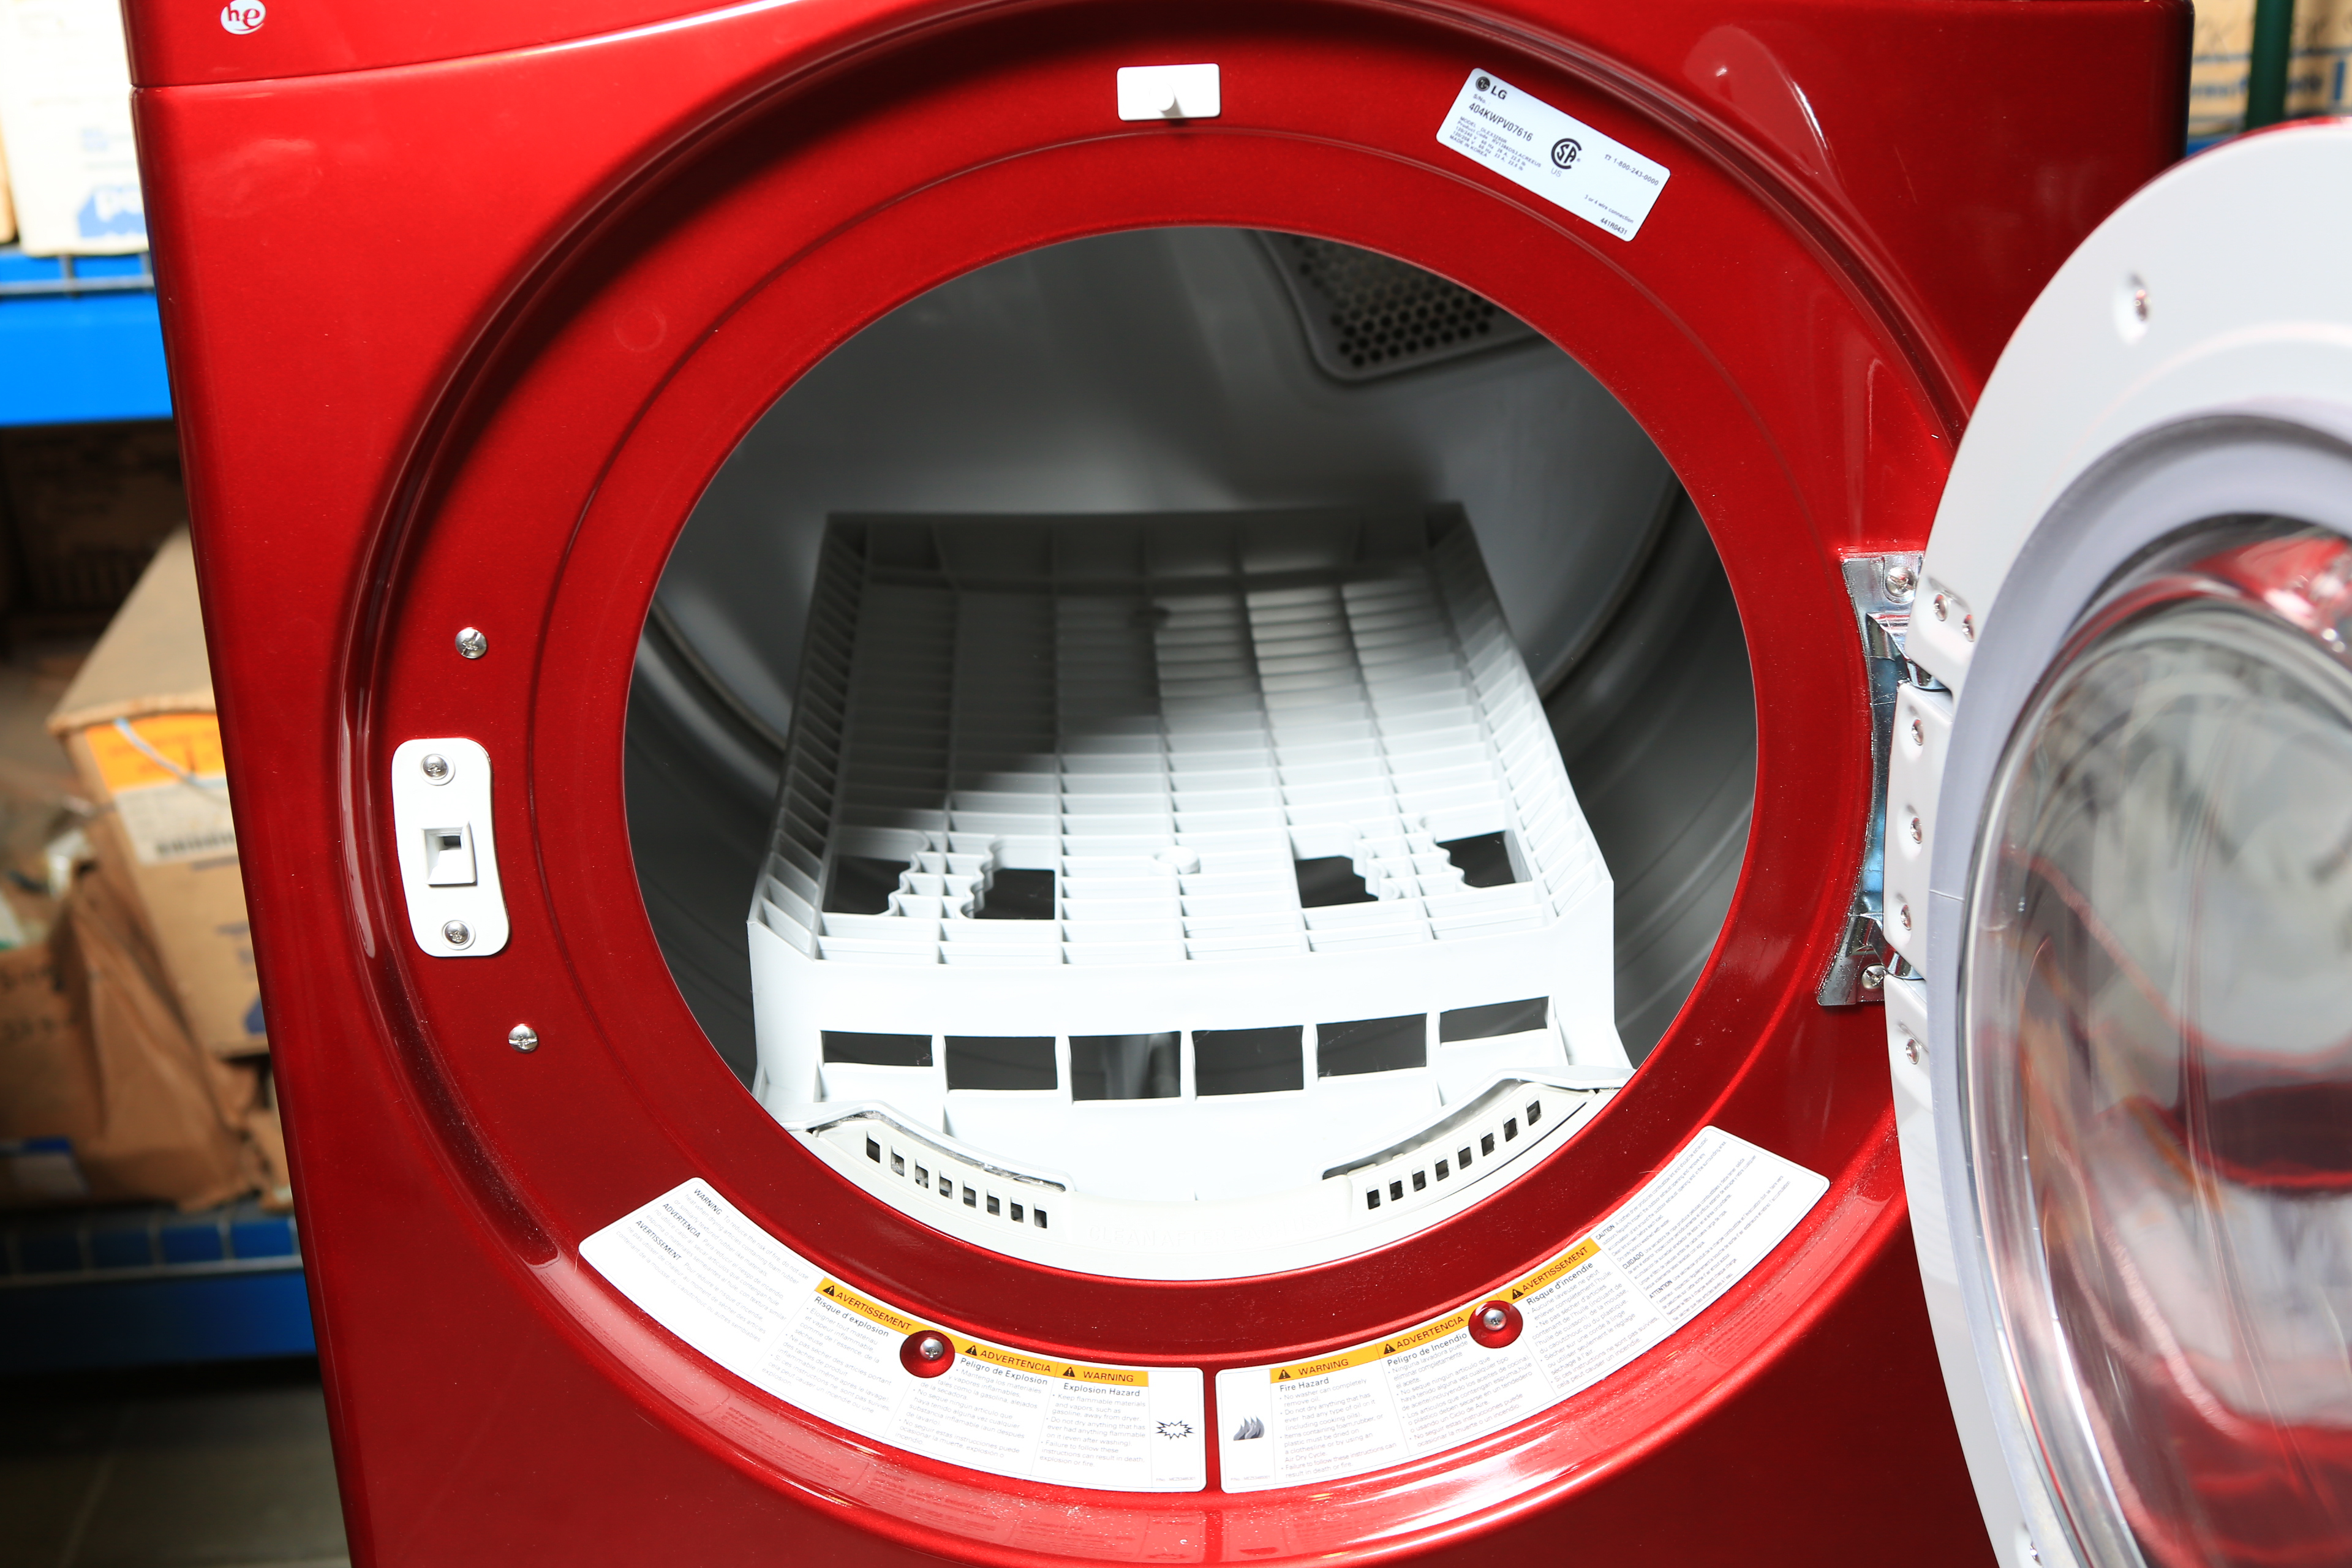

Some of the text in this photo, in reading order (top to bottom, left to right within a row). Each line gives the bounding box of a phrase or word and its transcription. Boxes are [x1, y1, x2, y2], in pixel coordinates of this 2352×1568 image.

[1490, 85, 1507, 99] LG
[1469, 102, 1532, 141] 404KWPV07616
[1550, 167, 1562, 177] US
[1613, 158, 1659, 186] 1-800-243-0000
[1608, 208, 1634, 224] connection
[1600, 217, 1627, 235] 441R0431
[694, 1188, 722, 1215] WARNING
[662, 1203, 700, 1237] ADVERTENCIA
[635, 1220, 681, 1260] AVERTISSEMENT
[1595, 1224, 1615, 1240] CAUTION
[1523, 1246, 1587, 1291] AVERTISSEMENT
[1622, 1251, 1644, 1269] CUIDADO
[1526, 1263, 1593, 1305] Risque d'incendie
[1649, 1280, 1672, 1298] ATTENTION
[814, 1295, 888, 1336] Risque d'explosion
[836, 1292, 911, 1329] AVERTISSEMENT
[1396, 1316, 1464, 1348] ADVERTENCIA
[1387, 1352, 1417, 1366] Peligro
[1430, 1333, 1467, 1351] Incendio
[960, 1357, 990, 1371] Peligro
[980, 1350, 1050, 1371] ADVERTENCIA
[1298, 1359, 1348, 1374] WARNING
[1083, 1371, 1133, 1382] WARNING
[1298, 1376, 1329, 1389] Hazard
[1063, 1382, 1140, 1396] Explosion Hazard
